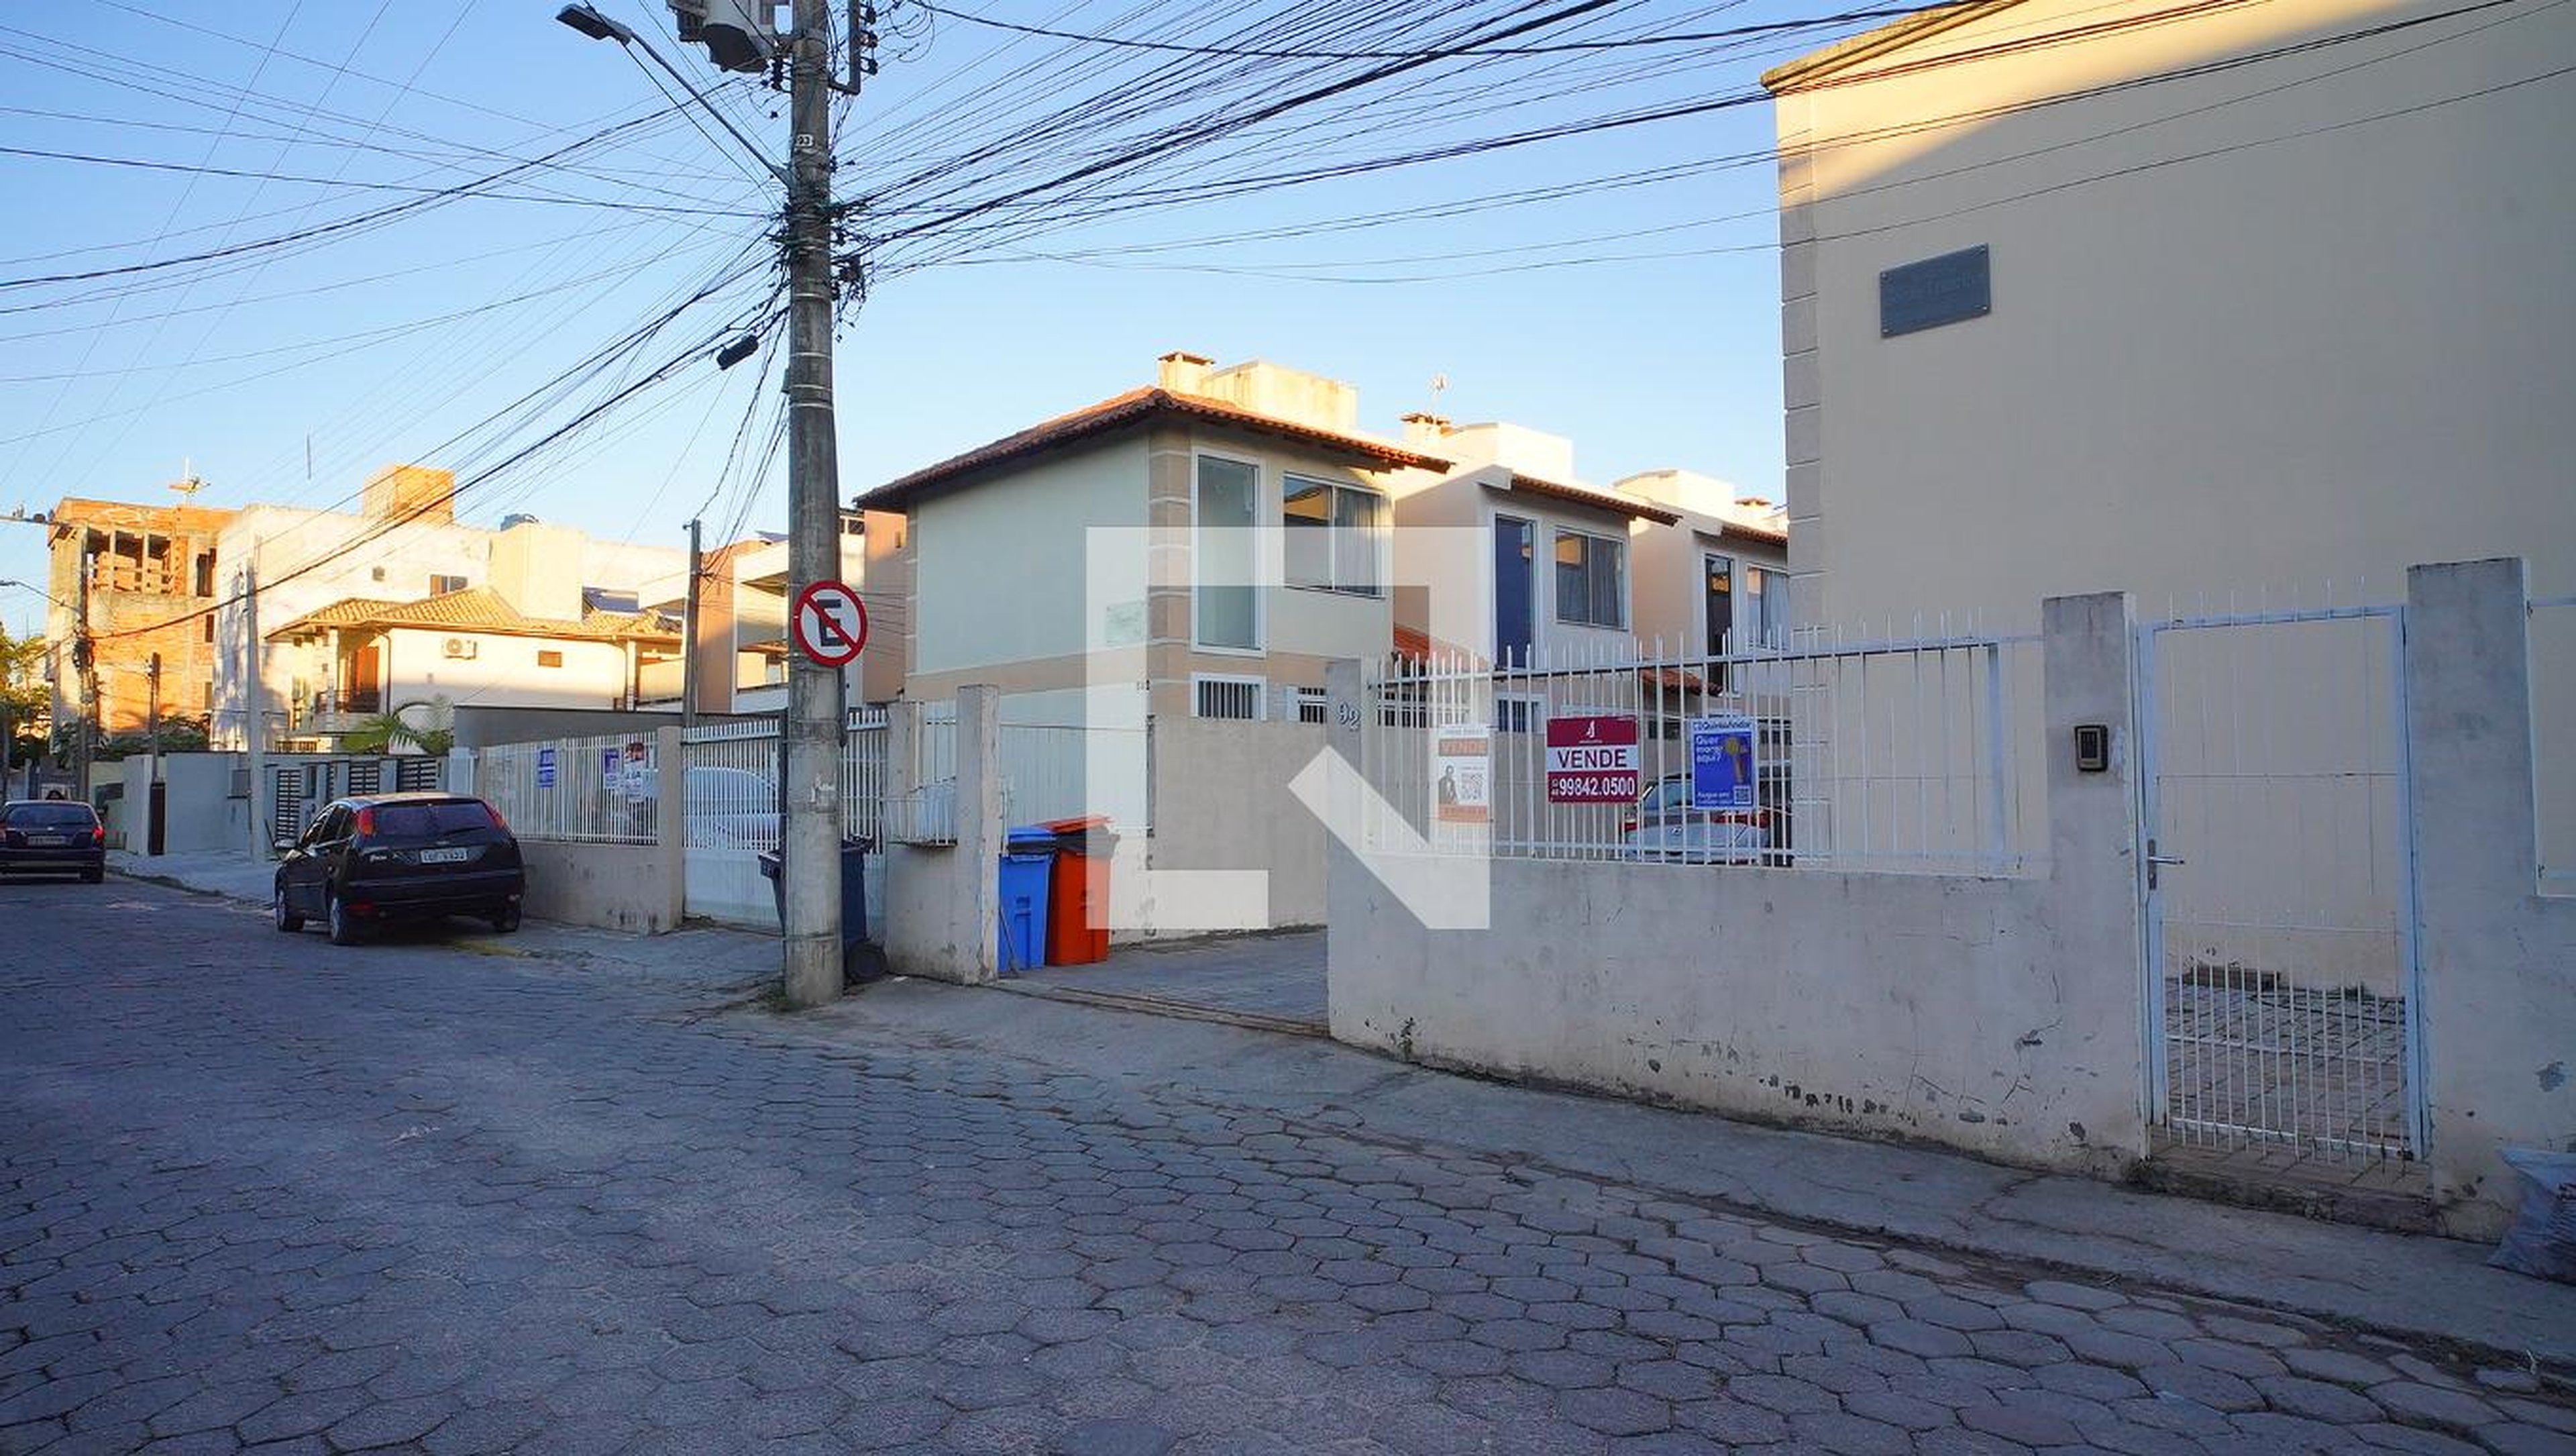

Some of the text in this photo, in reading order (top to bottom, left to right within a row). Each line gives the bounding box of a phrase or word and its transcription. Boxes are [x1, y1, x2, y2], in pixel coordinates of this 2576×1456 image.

[816, 599, 847, 647] E
[1557, 749, 1627, 768] VENDE
[1559, 777, 1635, 796] 99842.0500
